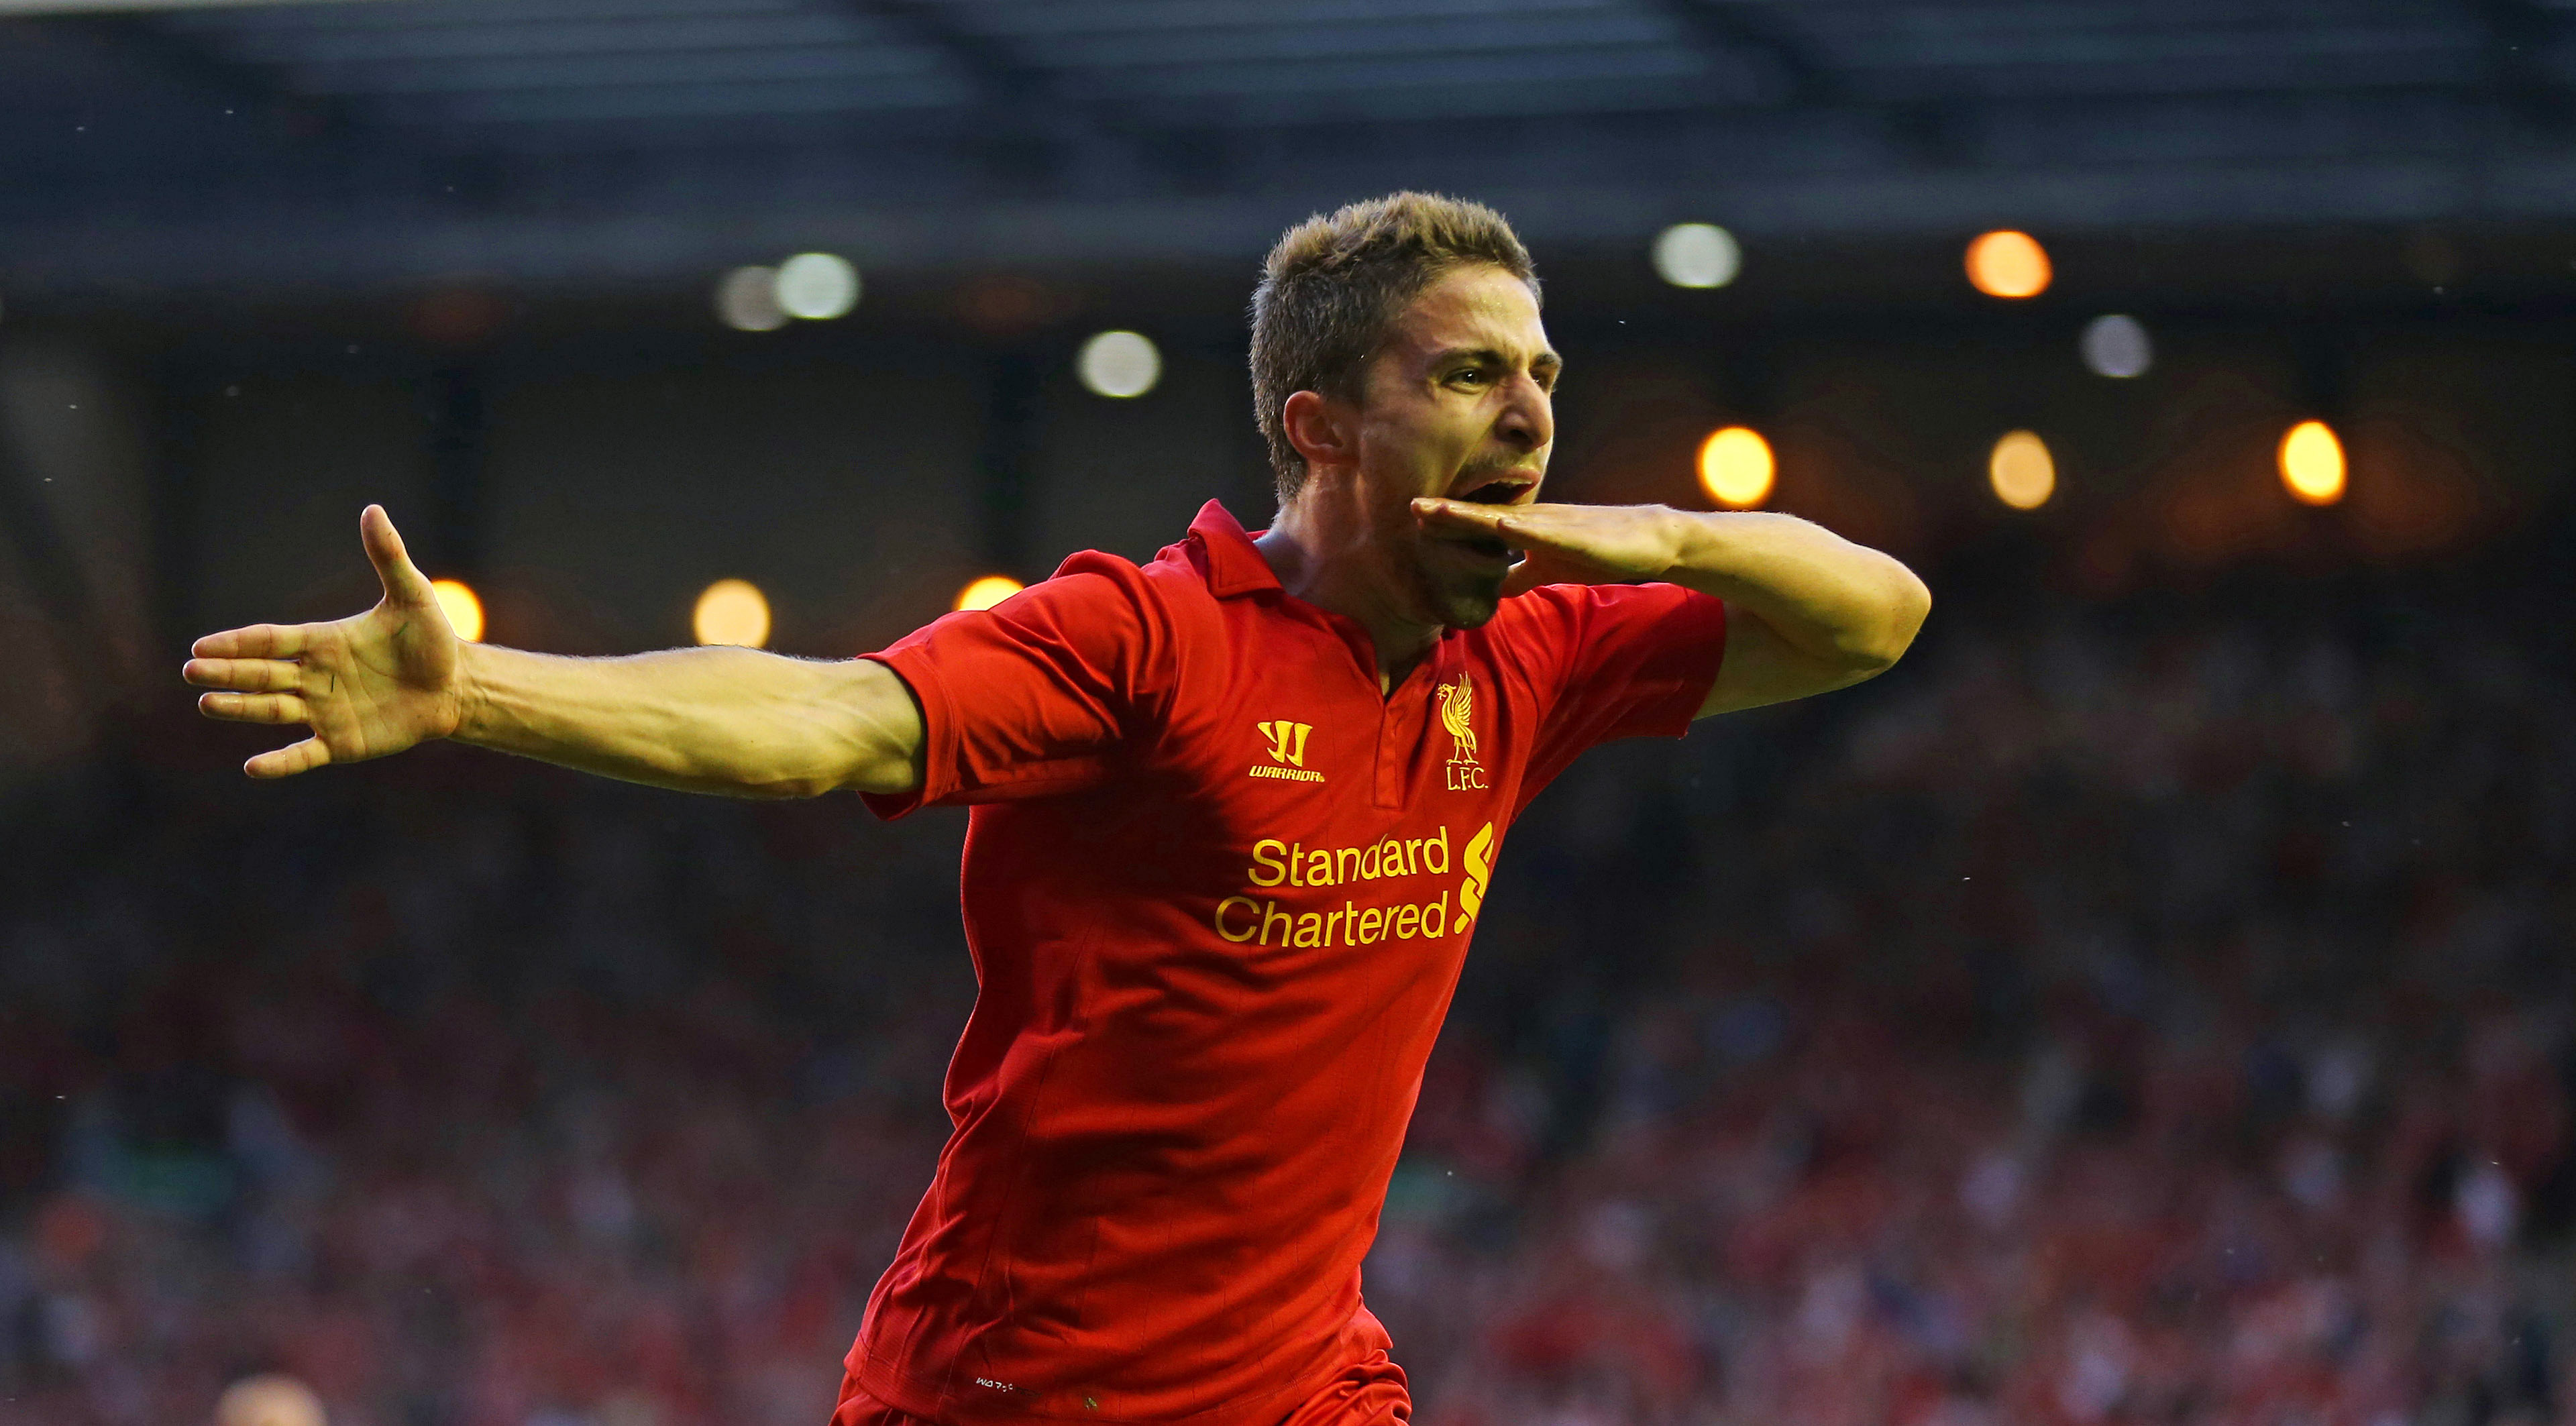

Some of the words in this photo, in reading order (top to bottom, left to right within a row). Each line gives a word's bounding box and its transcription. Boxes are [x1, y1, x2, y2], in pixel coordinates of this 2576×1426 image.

[1248, 765, 1324, 782] WARRIOR
[1446, 766, 1489, 791] L.F.C.
[1248, 826, 1449, 887] Standard
[1215, 890, 1448, 948] Chartered
